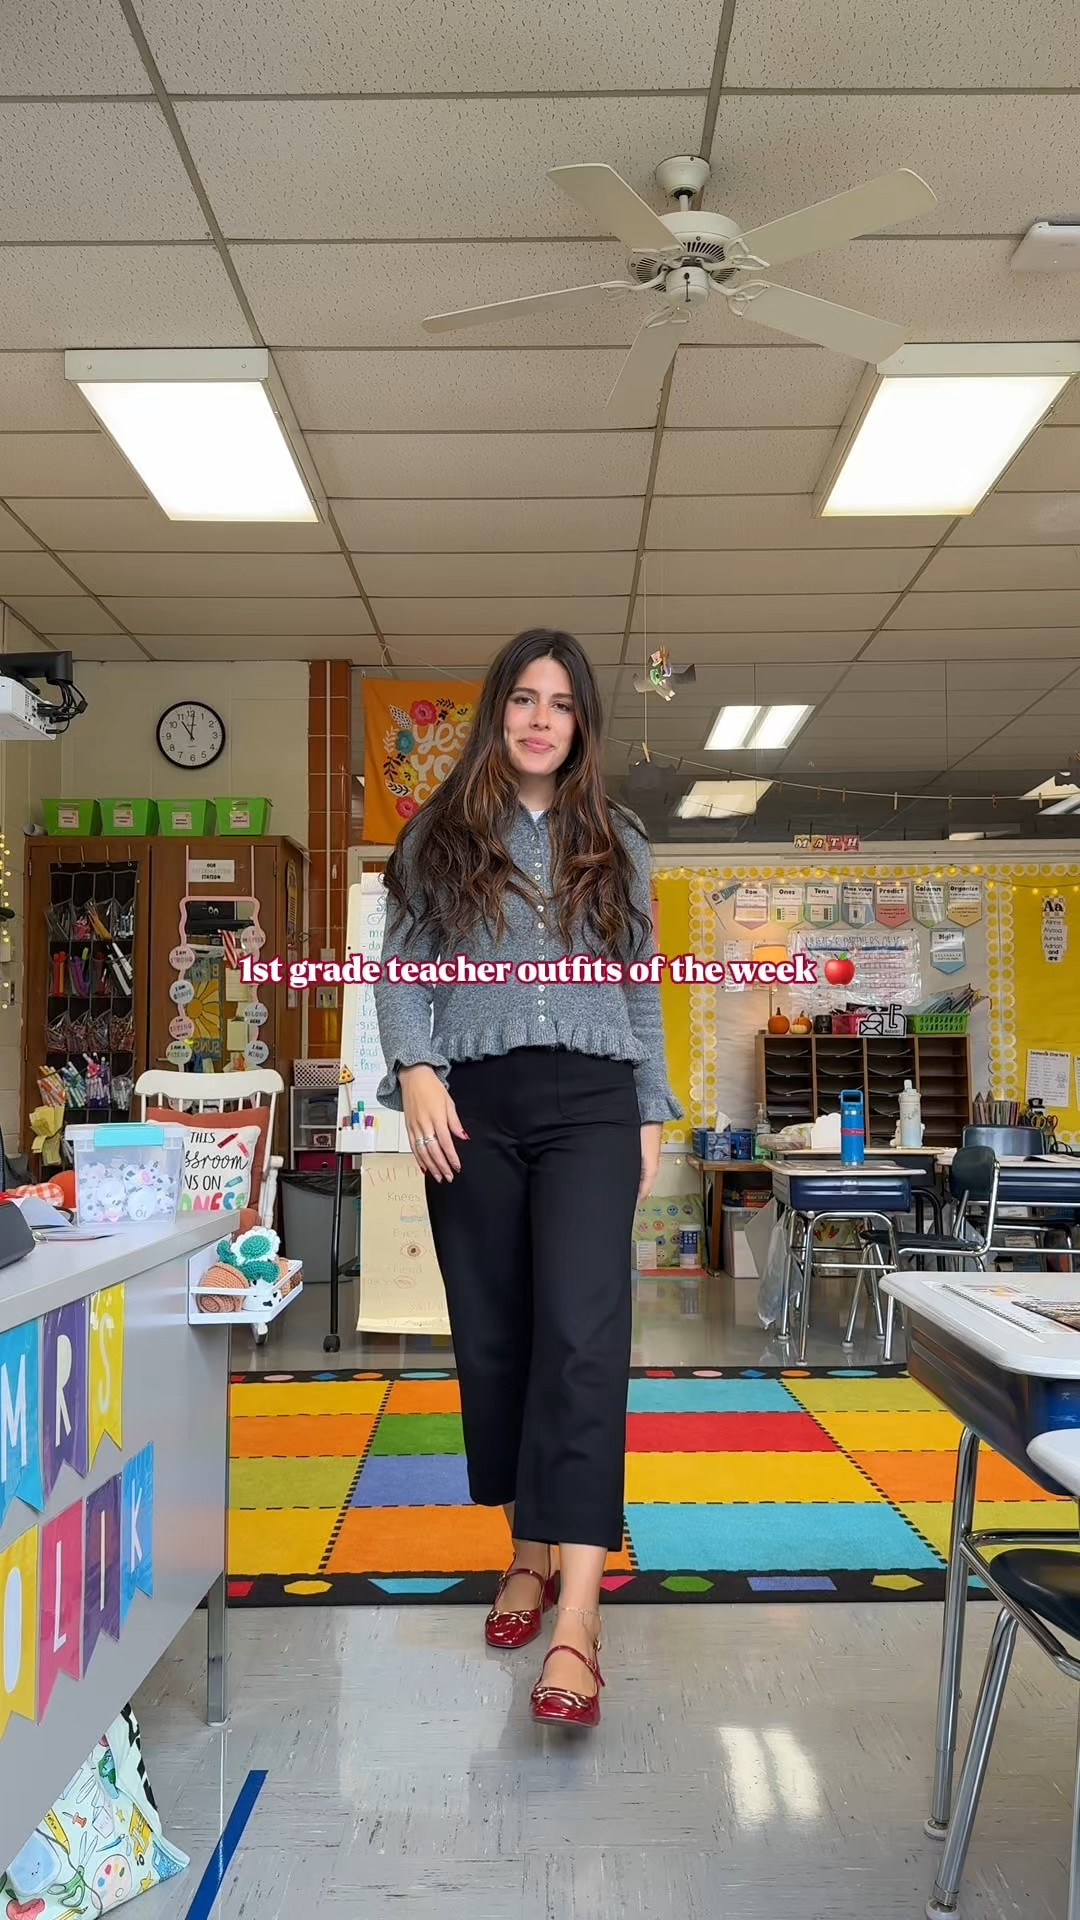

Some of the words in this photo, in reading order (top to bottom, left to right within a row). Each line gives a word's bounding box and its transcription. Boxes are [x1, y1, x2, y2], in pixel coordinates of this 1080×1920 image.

[187, 710, 196, 718] 12
[169, 721, 178, 729] 10
[208, 720, 214, 728] 2
[166, 732, 171, 740] 9
[212, 732, 218, 740] 3
[178, 751, 184, 759] 7
[190, 754, 196, 762] 6
[201, 751, 207, 759] 5
[795, 837, 858, 849] MATH
[778, 888, 796, 896] Ones
[814, 887, 830, 895] Tens
[1043, 900, 1064, 912] Aa
[938, 933, 955, 941] Digit
[190, 1131, 216, 1143] THIS
[184, 1150, 249, 1170] ssroom
[203, 1175, 221, 1191] ON
[388, 1192, 421, 1202] Knees
[1, 1312, 115, 1484] MRS
